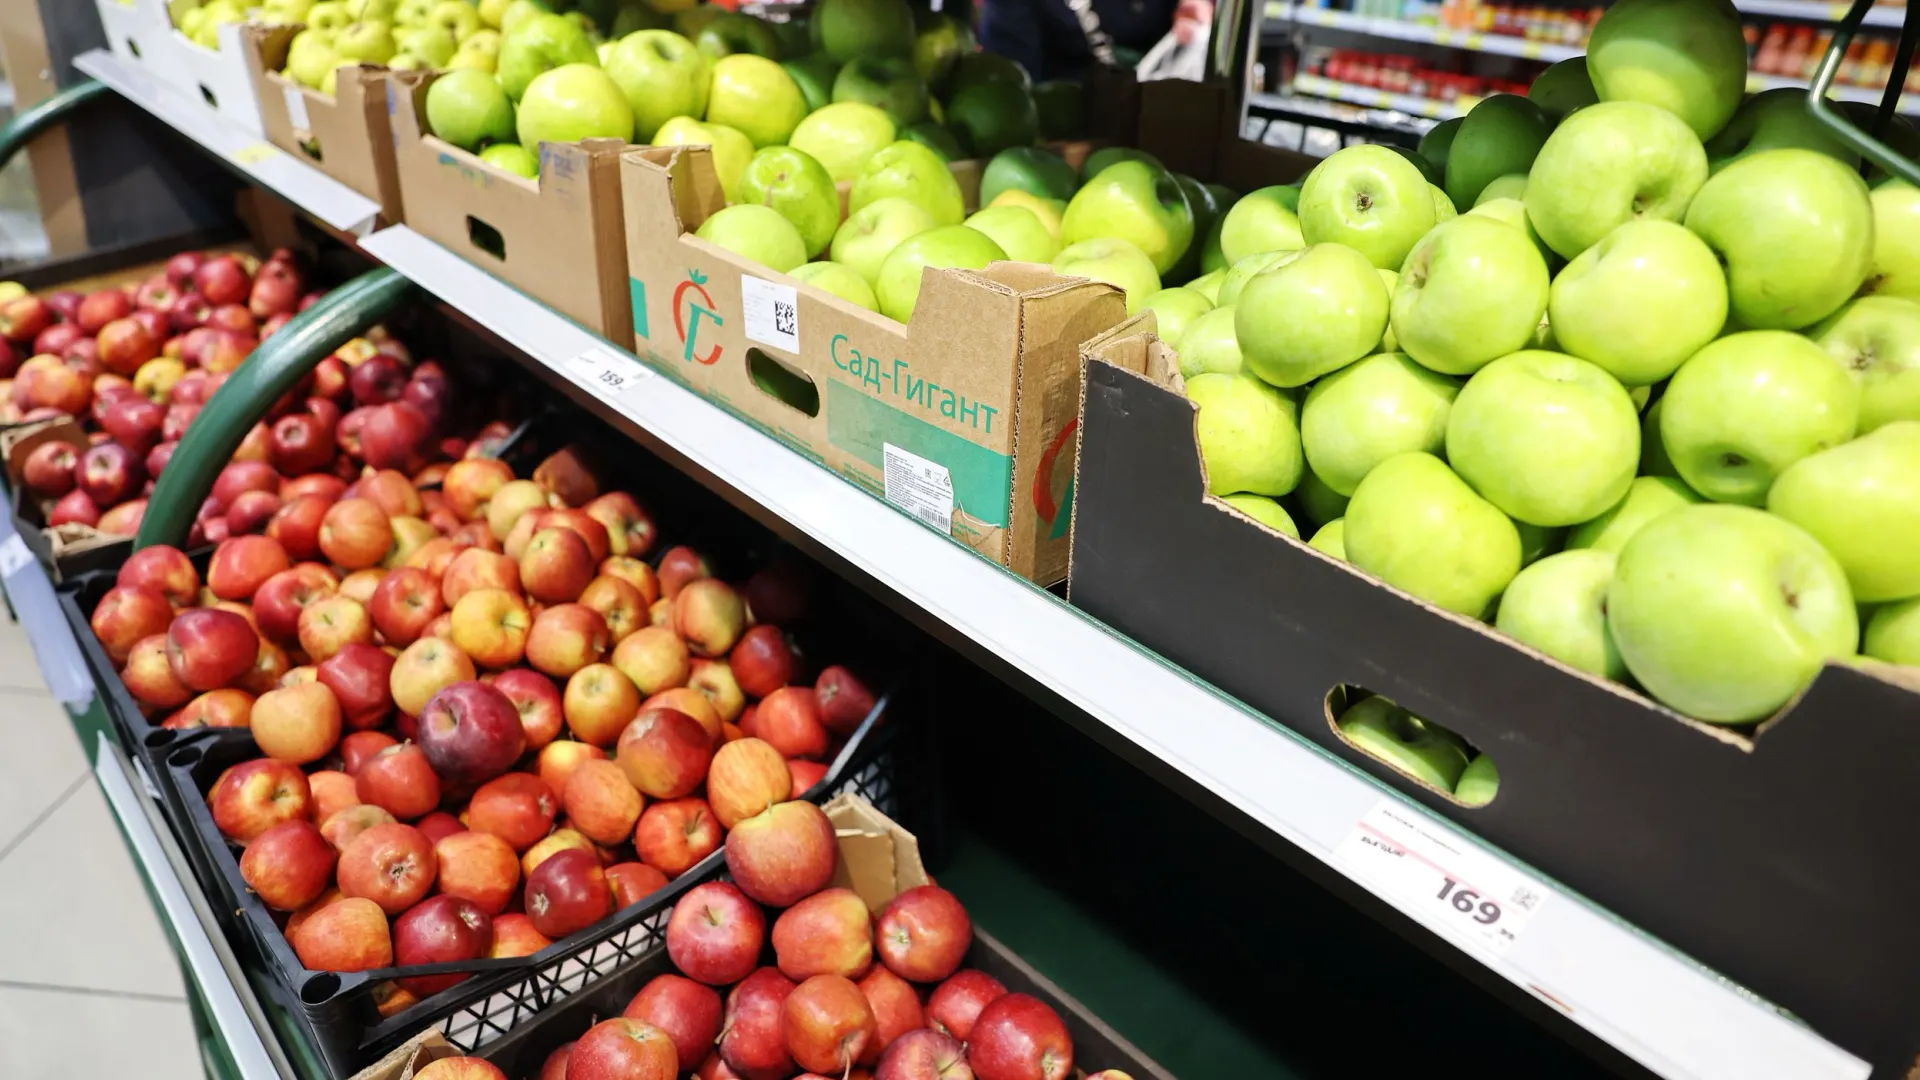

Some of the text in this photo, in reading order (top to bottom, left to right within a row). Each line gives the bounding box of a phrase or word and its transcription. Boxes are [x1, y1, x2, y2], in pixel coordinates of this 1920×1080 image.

[599, 370, 624, 386] 159
[831, 333, 998, 434] Сад-Гигант
[1437, 877, 1501, 924] 169
